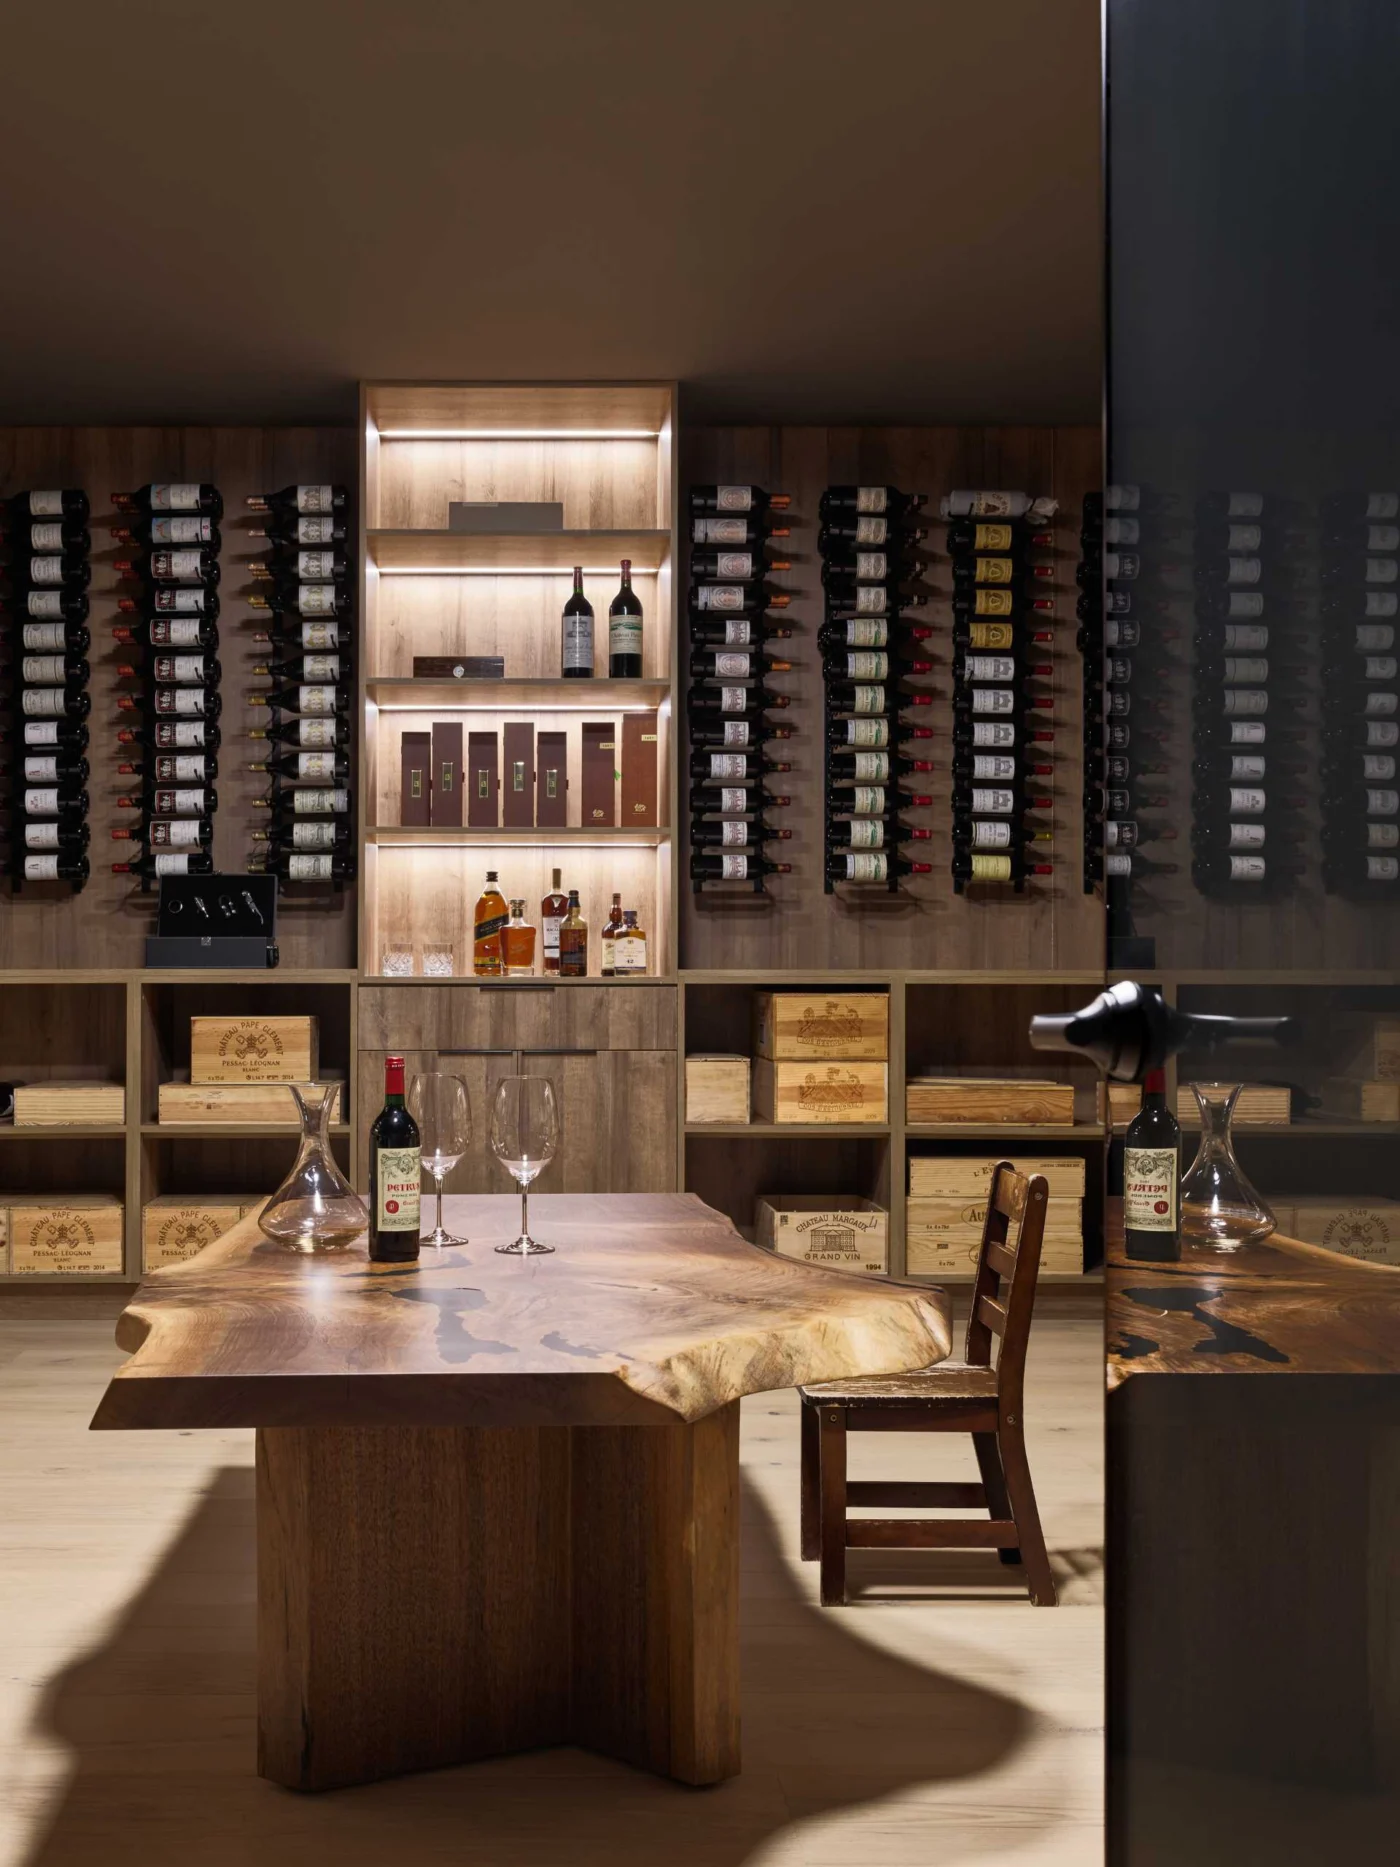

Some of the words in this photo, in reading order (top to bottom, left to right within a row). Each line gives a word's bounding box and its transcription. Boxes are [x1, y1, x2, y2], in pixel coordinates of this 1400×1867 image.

[240, 1021, 260, 1029] PAPE
[52, 1211, 71, 1219] PAPE
[181, 1210, 200, 1218] PAPE
[796, 1214, 829, 1233] CHATEAU
[833, 1214, 867, 1233] MARGAUX
[804, 1253, 841, 1261] GRAND
[844, 1253, 861, 1261] VIN
